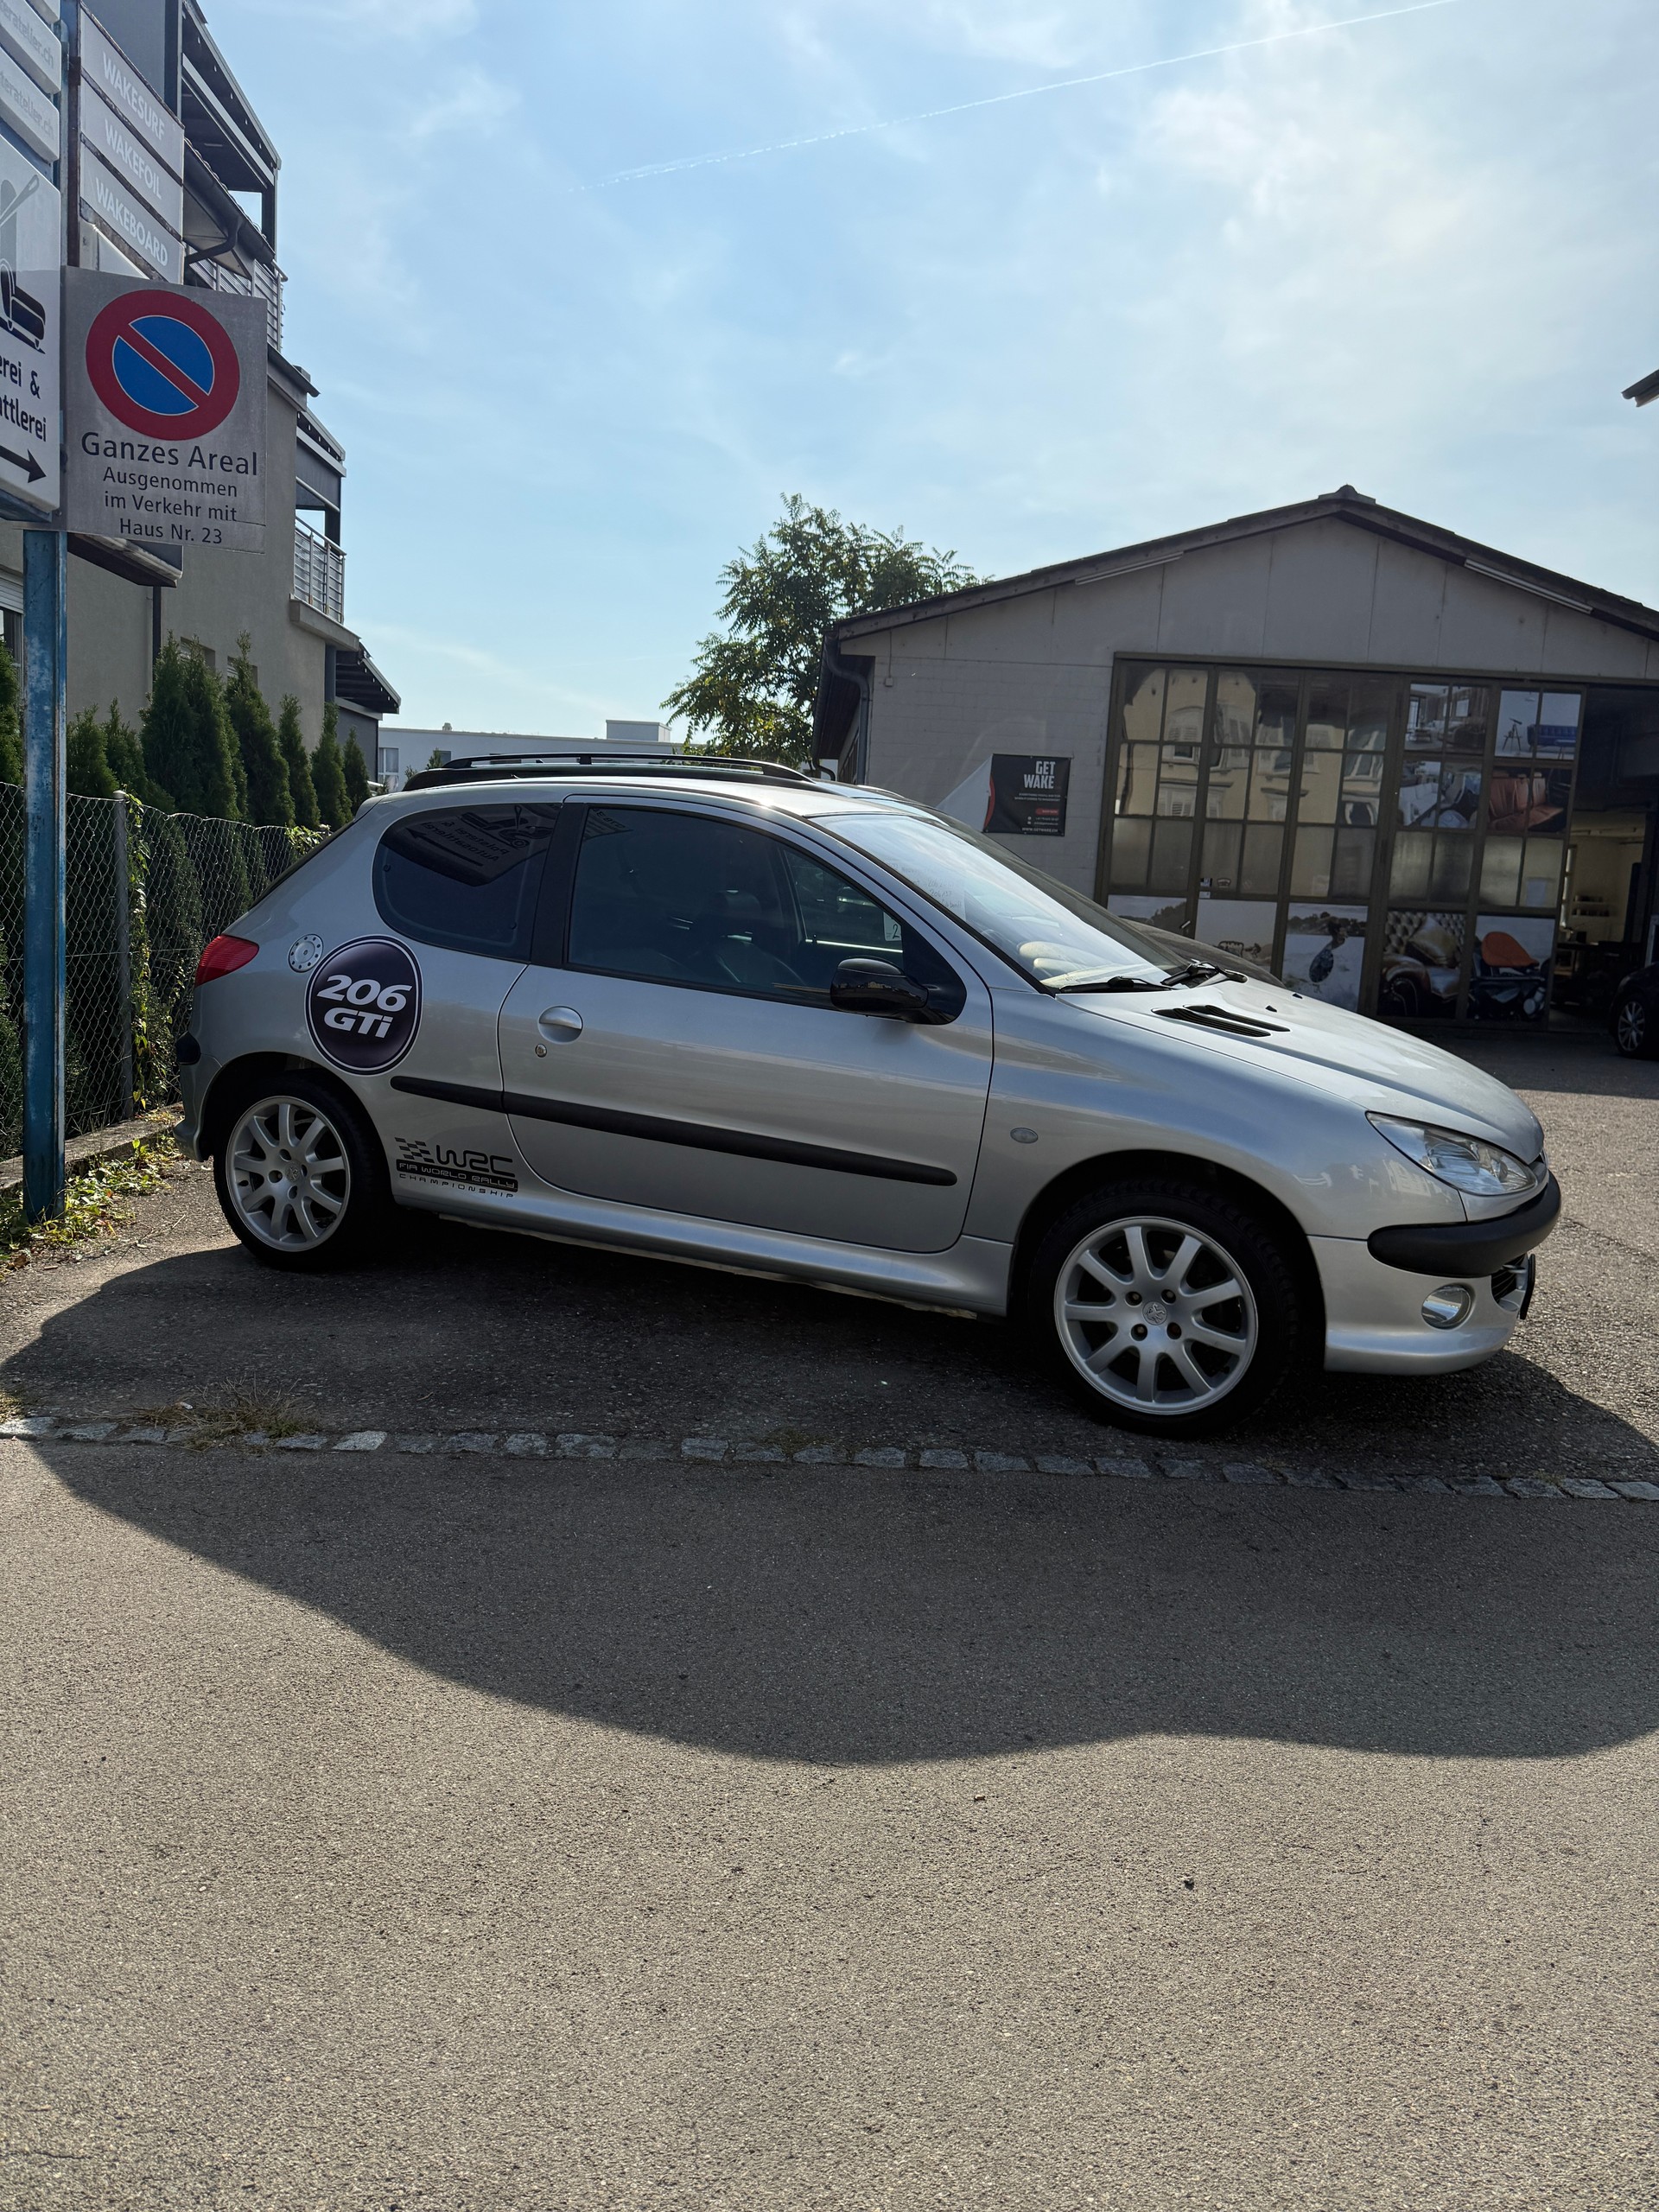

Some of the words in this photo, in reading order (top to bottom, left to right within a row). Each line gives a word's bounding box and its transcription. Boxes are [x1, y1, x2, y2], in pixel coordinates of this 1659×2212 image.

[103, 52, 165, 141] WAKESURF
[105, 118, 162, 200] WAKEFOIL
[95, 177, 168, 266] WAKEBOARD
[0, 355, 22, 387] rei
[30, 370, 41, 399] &
[0, 394, 46, 442] ttlerei
[81, 431, 179, 466] Ganzes
[188, 445, 257, 475] Areal
[103, 467, 238, 498] Ausgenommen
[105, 491, 126, 509] im
[132, 494, 201, 518] Verkehr
[207, 505, 238, 522] mit
[120, 518, 164, 537] Haus
[171, 524, 194, 542] Nr.
[201, 527, 223, 544] 23
[1023, 774, 1055, 790] WAKE
[1035, 760, 1056, 776] GET
[316, 974, 412, 1013] 206
[323, 1007, 394, 1039] GTi
[399, 1162, 418, 1171] FIA
[421, 1166, 467, 1179] WORLD
[472, 1176, 515, 1189] RALLY
[436, 1144, 516, 1178] WRC
[399, 1173, 514, 1198] CHAMPIONSHIP
